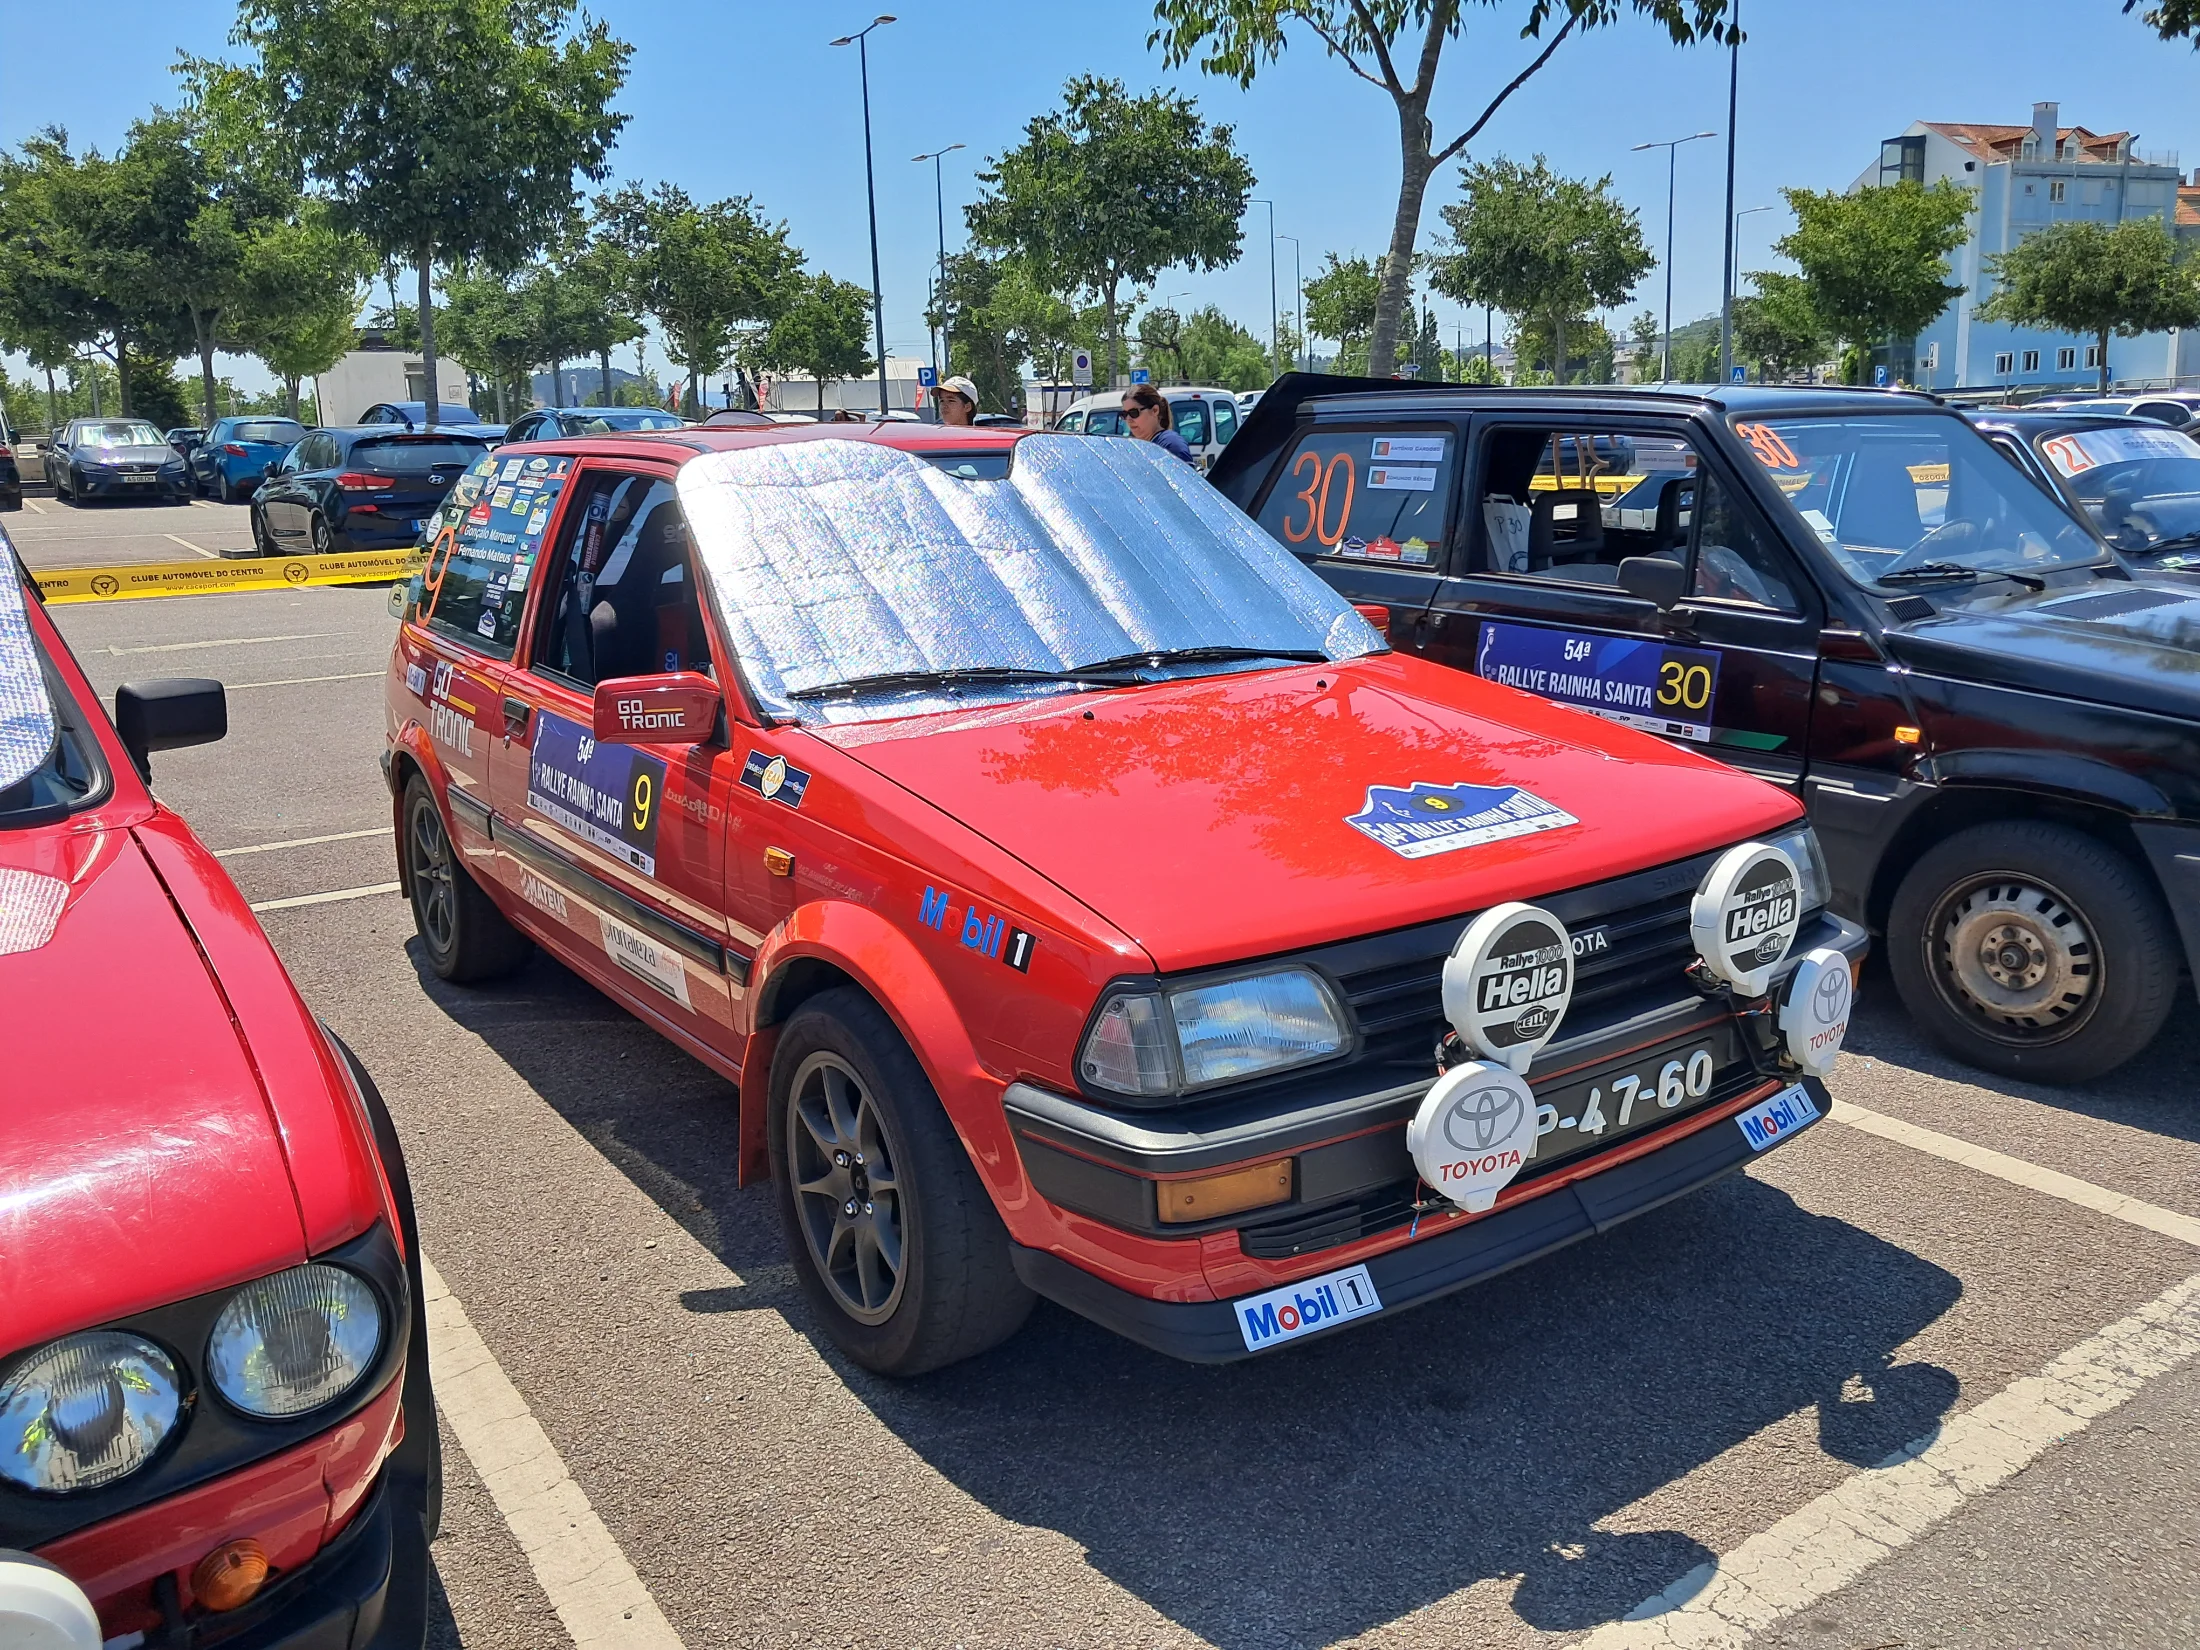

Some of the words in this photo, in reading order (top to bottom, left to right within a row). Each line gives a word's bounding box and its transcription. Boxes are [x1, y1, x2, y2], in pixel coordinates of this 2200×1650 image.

[921, 369, 932, 385] P
[1735, 423, 1798, 468] 30
[2047, 435, 2095, 473] 27
[590, 504, 609, 521] OK
[1283, 451, 1355, 546] 30
[464, 525, 489, 541] Gonçalo
[489, 529, 516, 544] Marques
[319, 562, 345, 570] CLUBE
[347, 558, 394, 568] AUTOMÓVEL
[395, 557, 406, 565] DO
[457, 543, 487, 559] Fernando
[487, 550, 512, 564] Mateus
[38, 579, 70, 588] ENTRO
[131, 574, 160, 583] CLUBE
[161, 571, 215, 581] AUTOMÓVEL
[216, 569, 228, 577] DO
[230, 567, 264, 577] CENTRO
[416, 525, 455, 628] 9
[1563, 638, 1592, 662] 54ª
[432, 660, 454, 701] GO
[1497, 664, 1546, 691] RALLYE
[1548, 671, 1601, 701] RAINHA
[1604, 680, 1652, 709] SANTA
[1656, 661, 1711, 710] 30
[617, 699, 643, 714] GO
[618, 712, 686, 730] TRONIC
[430, 699, 475, 759] TRONIC
[577, 735, 595, 765] 54ª
[765, 768, 785, 786] TEAM
[540, 763, 567, 800] RALLYE
[566, 776, 595, 816] RAINHA
[595, 791, 623, 830] SANTA
[632, 774, 652, 831] 9
[1424, 797, 1450, 810] 9
[1406, 816, 1460, 840] RALLYE
[1455, 806, 1513, 832] RAINHA
[1499, 790, 1562, 818] SANTA
[528, 874, 568, 918] MATEUS
[1744, 886, 1771, 904] Rallye
[1772, 877, 1794, 899] 1000
[918, 885, 1005, 958] Mobil
[1012, 932, 1029, 967] 1
[1730, 896, 1793, 940] Hella
[1500, 952, 1534, 970] Rallye
[1534, 944, 1565, 965] 1000
[1571, 931, 1608, 956] OTA
[1483, 965, 1563, 1010] Hella
[1517, 1010, 1549, 1028] HELLA
[1810, 1020, 1846, 1052] TOYOTA
[1527, 1050, 1713, 1159] P-47-60
[1743, 1099, 1797, 1145] Mobil
[1794, 1094, 1809, 1114] 1
[1439, 1149, 1521, 1182] TOYOTA
[1244, 1285, 1340, 1342] Mobil
[1346, 1279, 1363, 1306] 1
